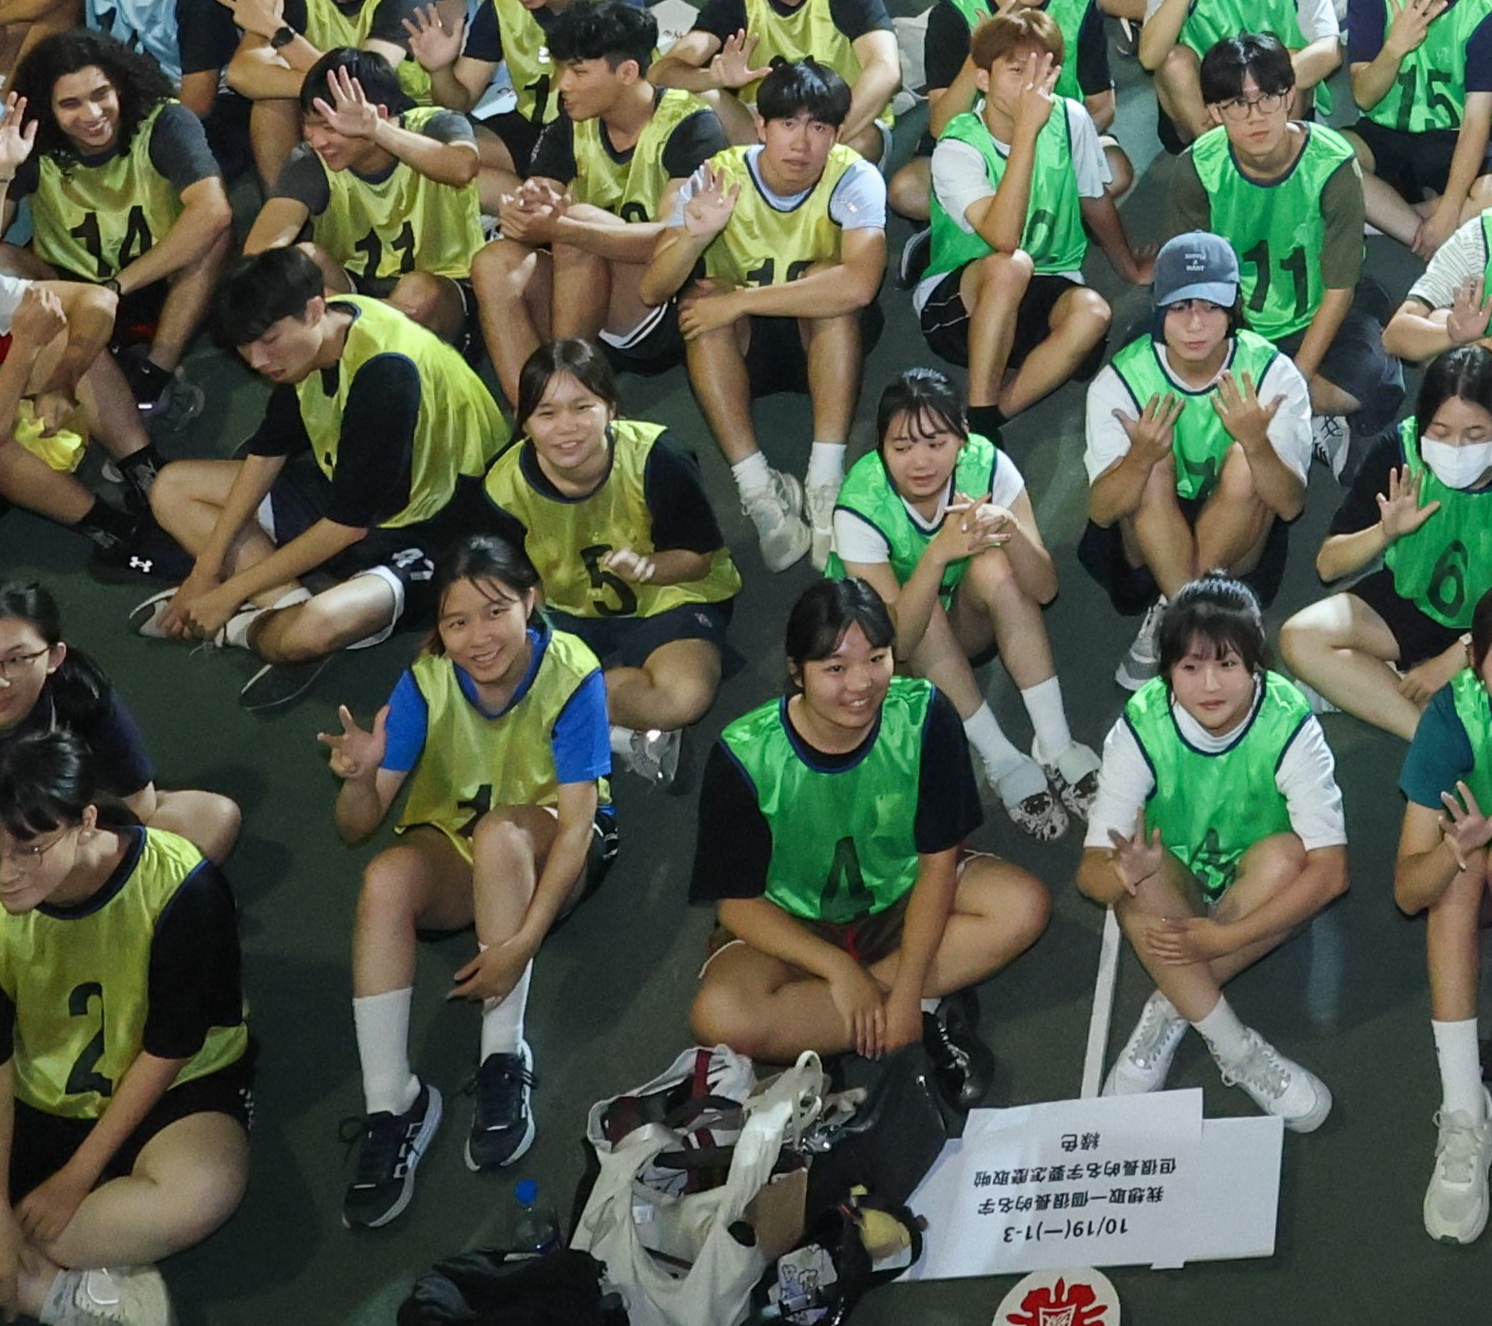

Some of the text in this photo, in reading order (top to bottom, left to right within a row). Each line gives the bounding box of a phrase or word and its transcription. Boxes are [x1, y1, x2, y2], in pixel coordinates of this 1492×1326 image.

[1398, 64, 1461, 132] 15
[72, 205, 152, 277] 14
[355, 221, 416, 278] 11
[1242, 240, 1308, 318] 11
[581, 546, 645, 627] 5
[1427, 540, 1468, 618] 6
[66, 981, 113, 1097] 2
[973, 1157, 1177, 1188] 但很長的名字要怎麼取啦
[1061, 1132, 1100, 1153] 綠色
[977, 1186, 1165, 1216] 我想取一個很長的名字
[1003, 1217, 1129, 1243] 10/19(一)1-3
